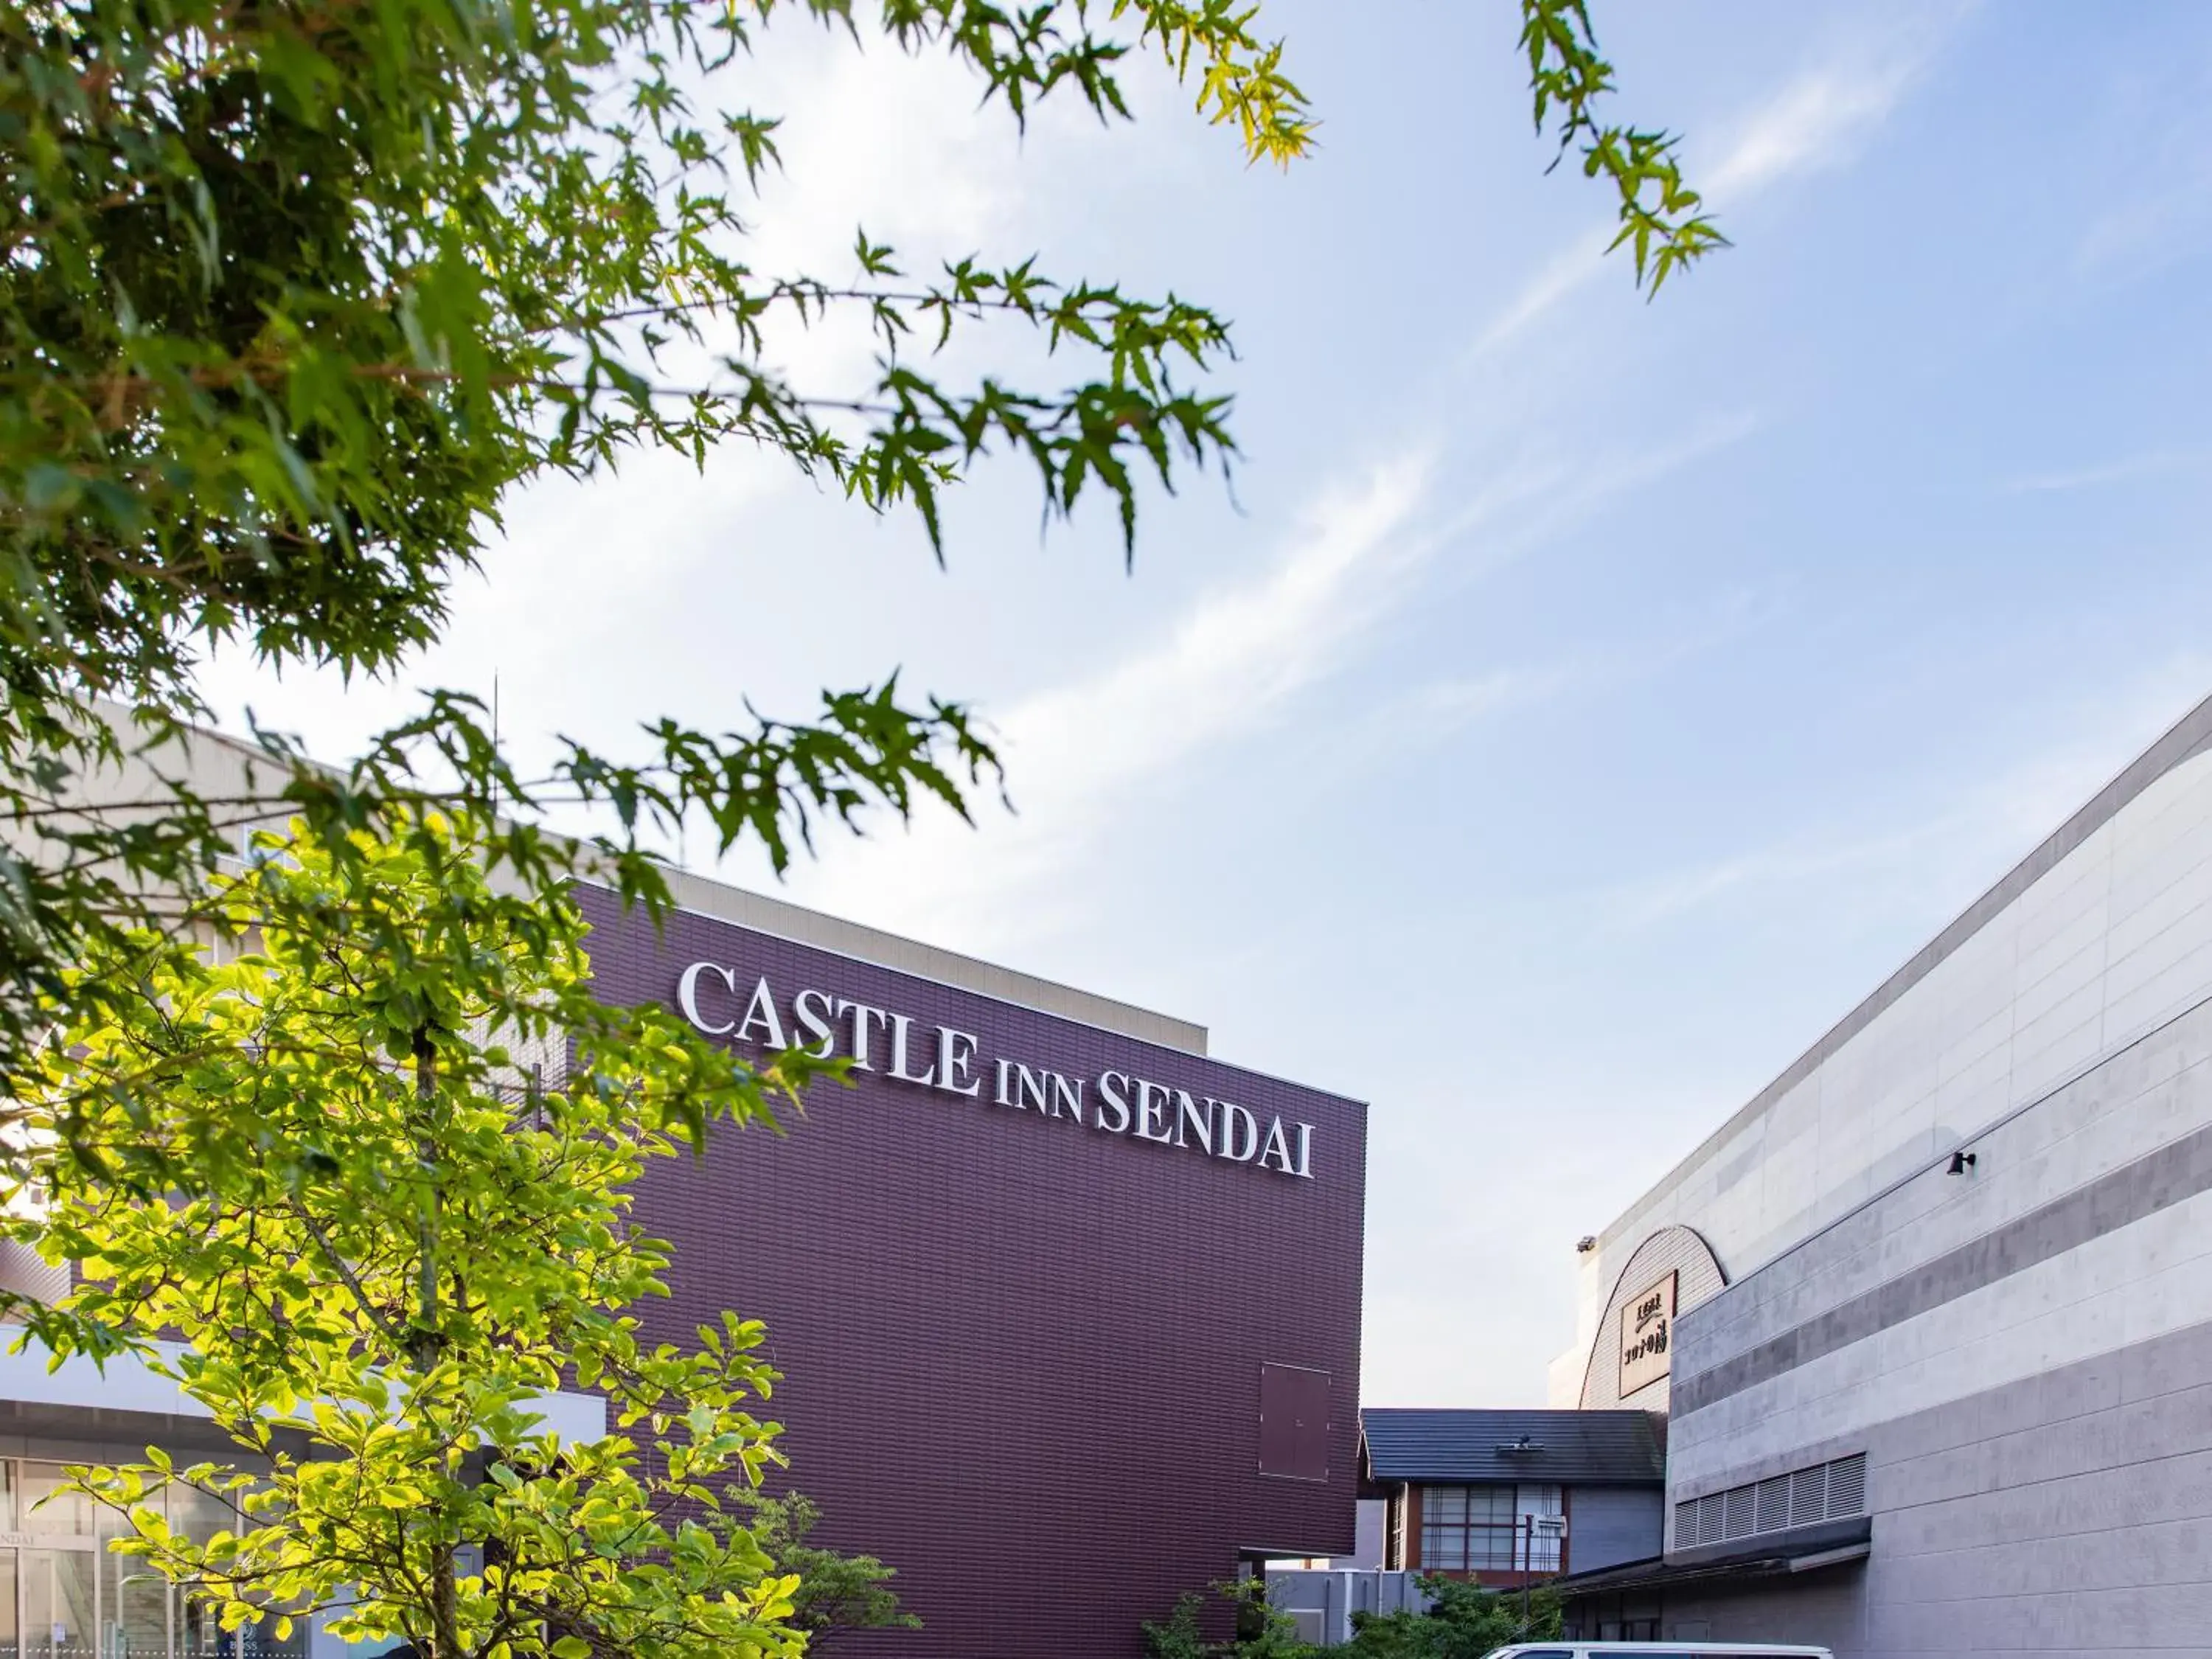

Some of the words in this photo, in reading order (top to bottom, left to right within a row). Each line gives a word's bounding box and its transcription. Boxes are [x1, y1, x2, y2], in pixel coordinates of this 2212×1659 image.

[678, 961, 981, 1097] CASTLE
[995, 1058, 1087, 1124] INN
[1098, 1071, 1317, 1179] SENDAI
